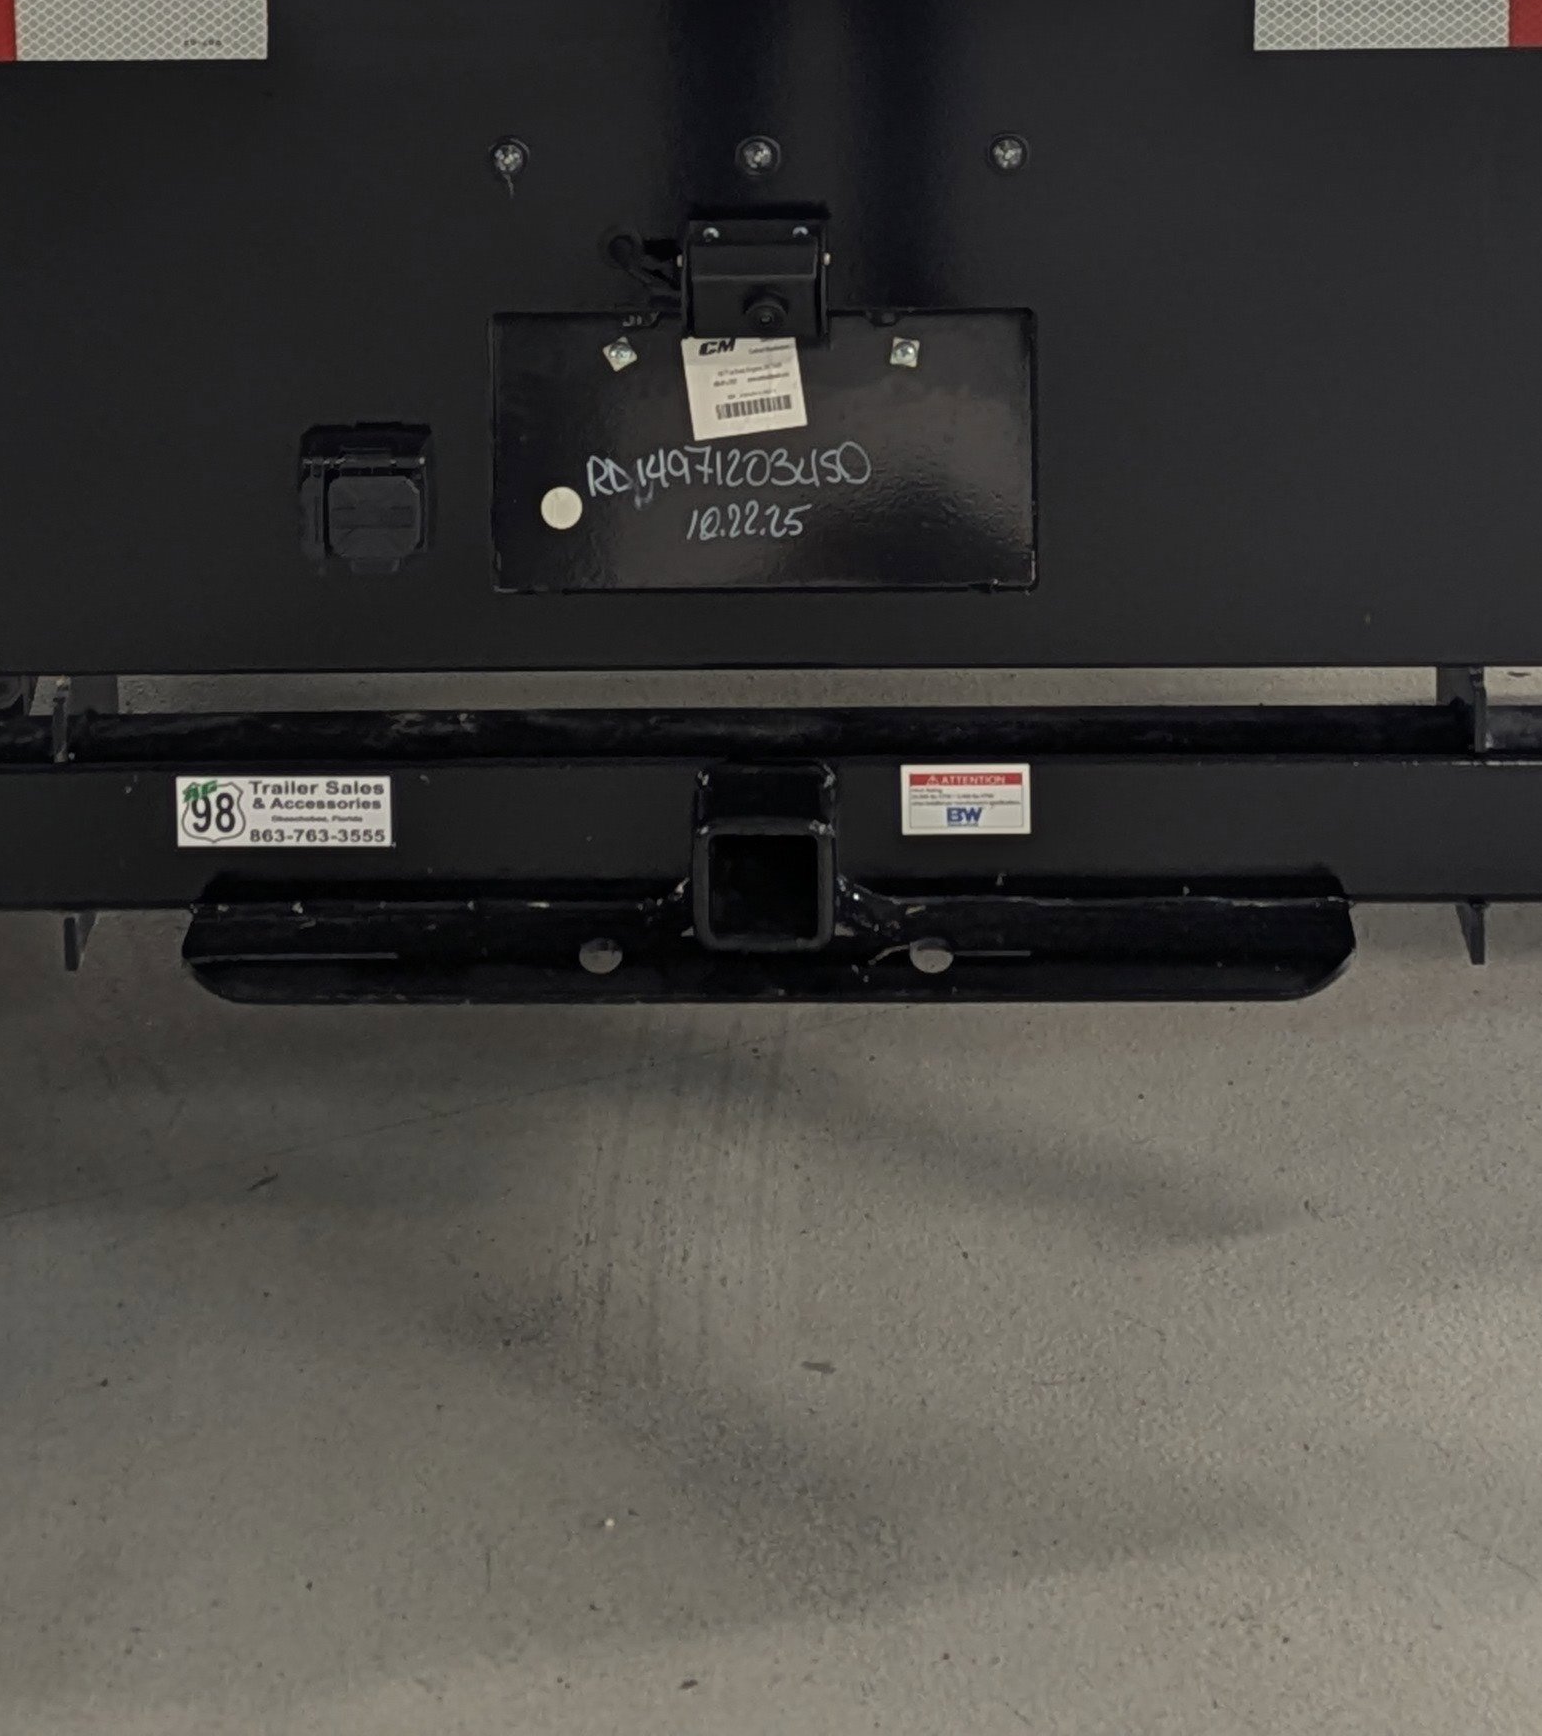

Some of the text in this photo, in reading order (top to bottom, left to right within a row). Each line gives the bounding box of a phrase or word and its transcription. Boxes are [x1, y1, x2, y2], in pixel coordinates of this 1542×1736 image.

[941, 775, 1006, 784] ATTENTION
[249, 780, 384, 795] Trailer Sales
[252, 797, 382, 810] & Accessories
[191, 792, 236, 833] 98
[249, 828, 386, 843] 863-763-3555
